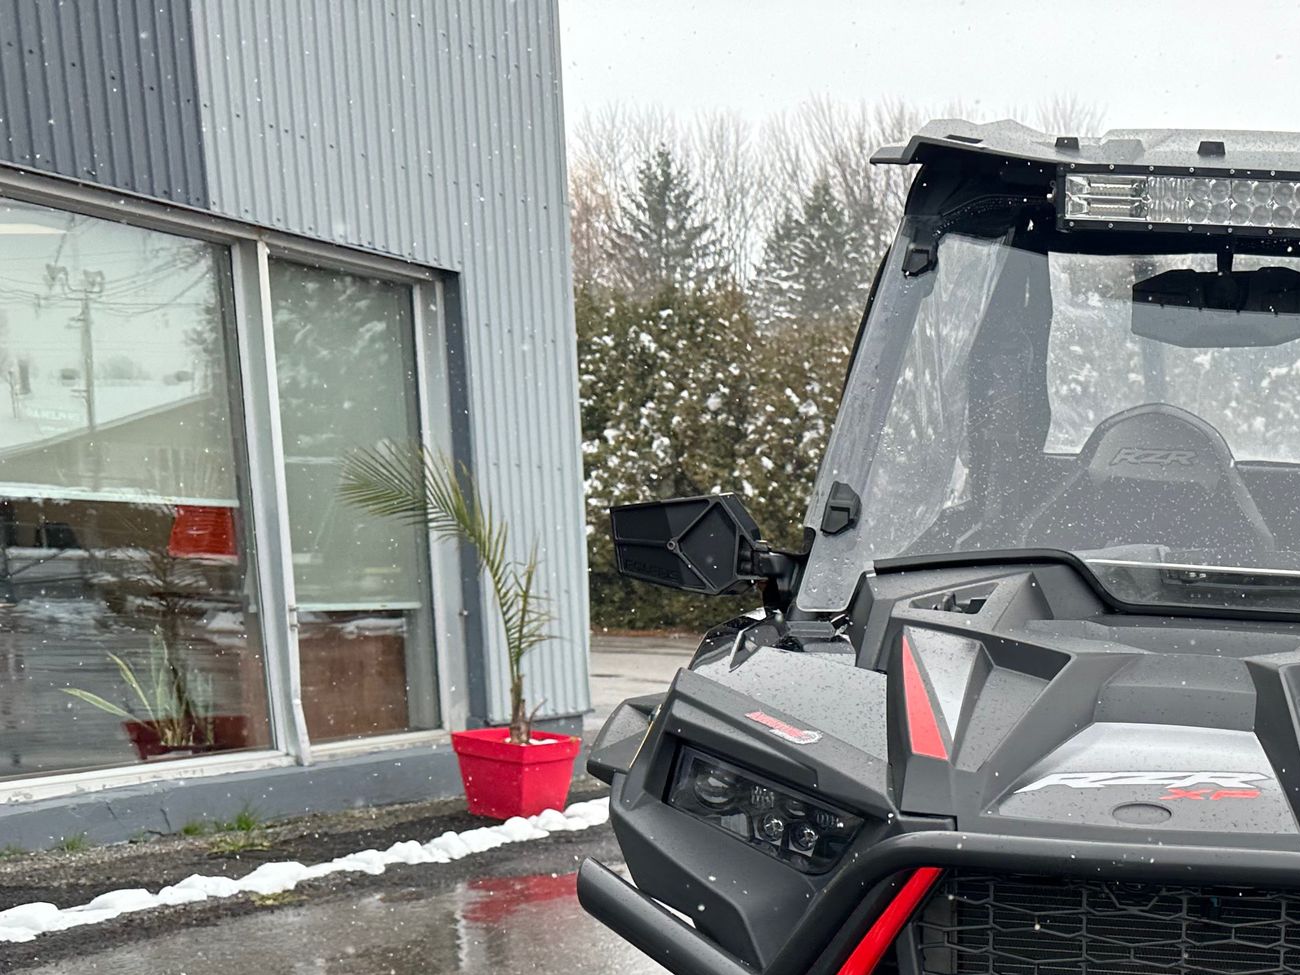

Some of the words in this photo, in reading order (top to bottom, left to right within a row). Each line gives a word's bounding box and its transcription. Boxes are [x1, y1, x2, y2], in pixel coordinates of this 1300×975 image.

[1109, 447, 1198, 467] RZR
[1013, 771, 1270, 794] RZR
[1159, 788, 1261, 801] XP
